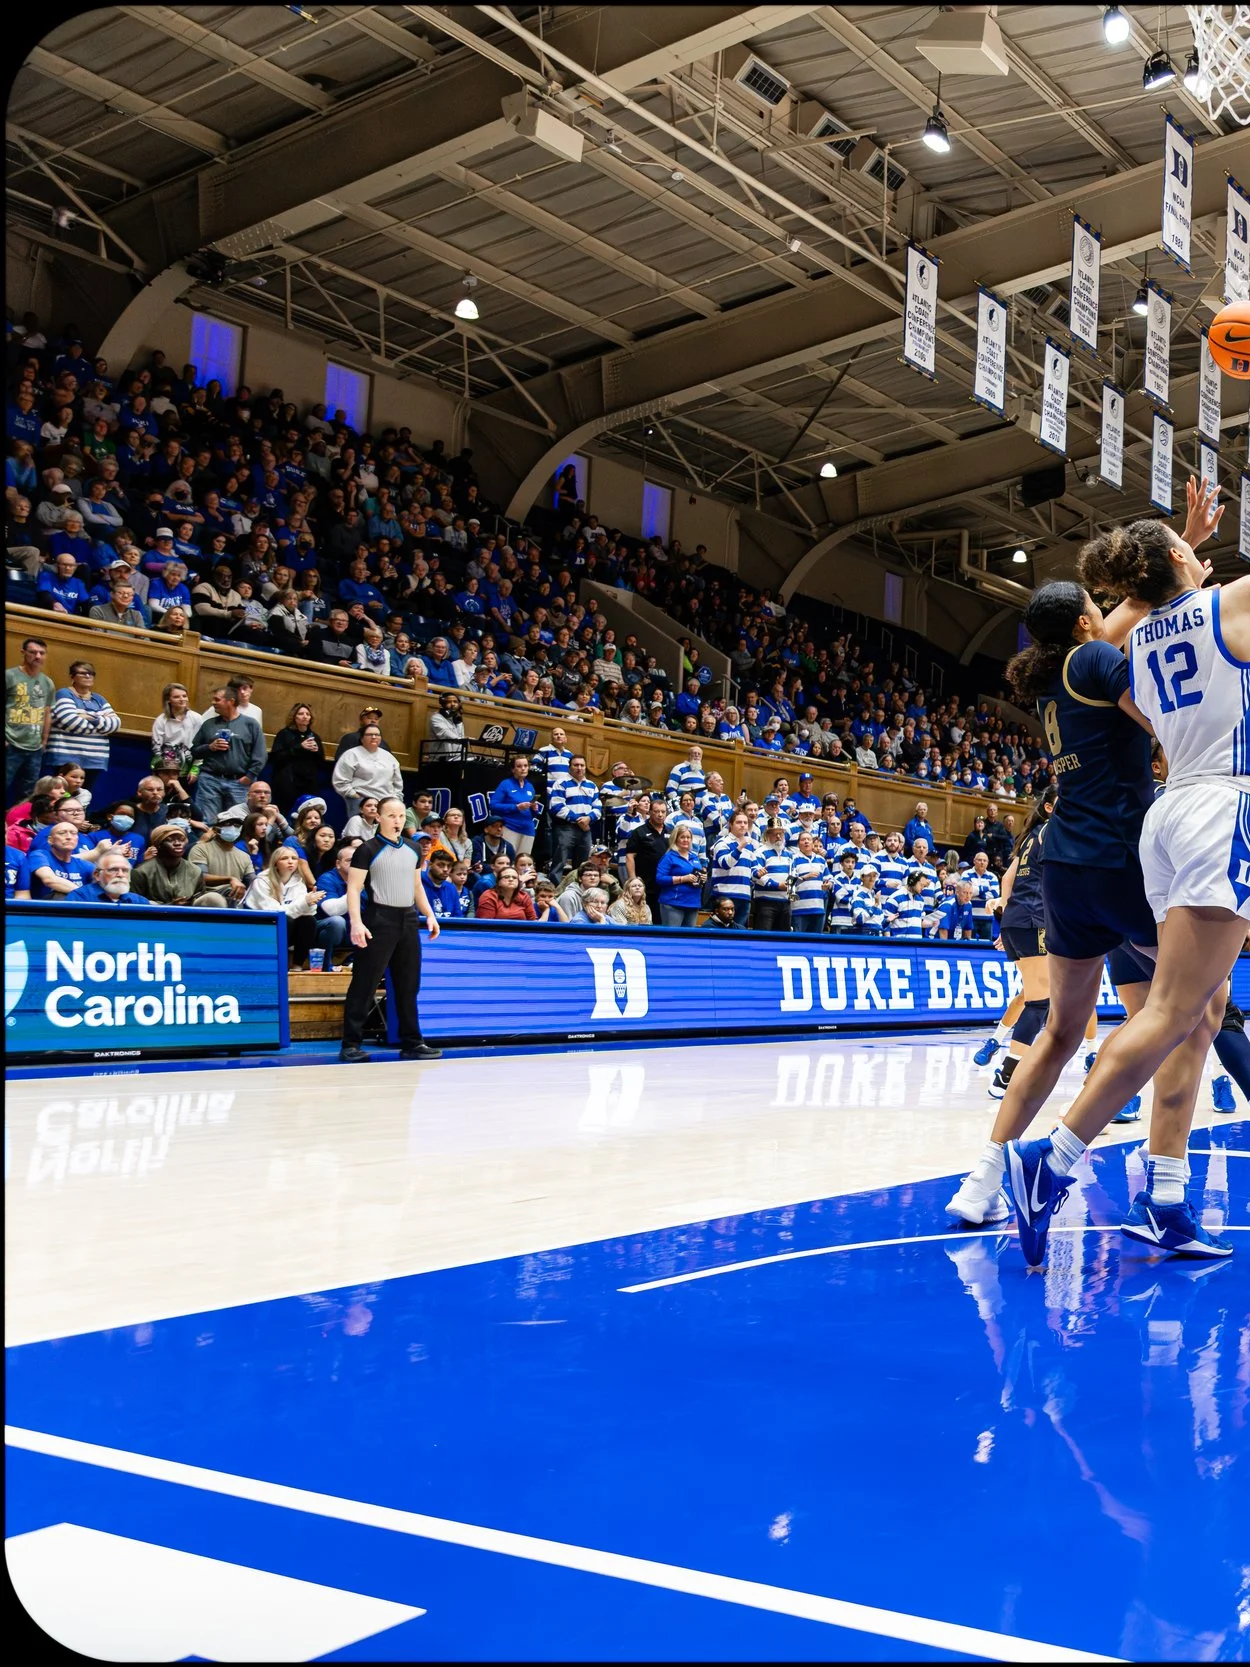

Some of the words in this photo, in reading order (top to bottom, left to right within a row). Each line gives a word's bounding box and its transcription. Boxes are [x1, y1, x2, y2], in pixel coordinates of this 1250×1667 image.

[1165, 202, 1179, 220] FINAL
[1179, 214, 1190, 230] FOUR
[1078, 268, 1095, 288] ATLANTIC
[1079, 280, 1092, 294] COAST
[912, 293, 932, 313] ATLANTIC
[1072, 285, 1098, 310] CONFERENCE
[1073, 296, 1096, 320] CHAMPIONS
[908, 310, 936, 335] CONFERENCE
[914, 305, 930, 320] COAST
[908, 322, 935, 344] CHAMPIONS
[1135, 607, 1205, 647] THOMAS
[1146, 640, 1203, 714] 12
[1020, 837, 1034, 866] 2
[45, 940, 182, 983] North
[776, 955, 915, 1013] DUKE
[44, 984, 241, 1028] Carolina
[94, 1050, 142, 1058] DAKTRONICS
